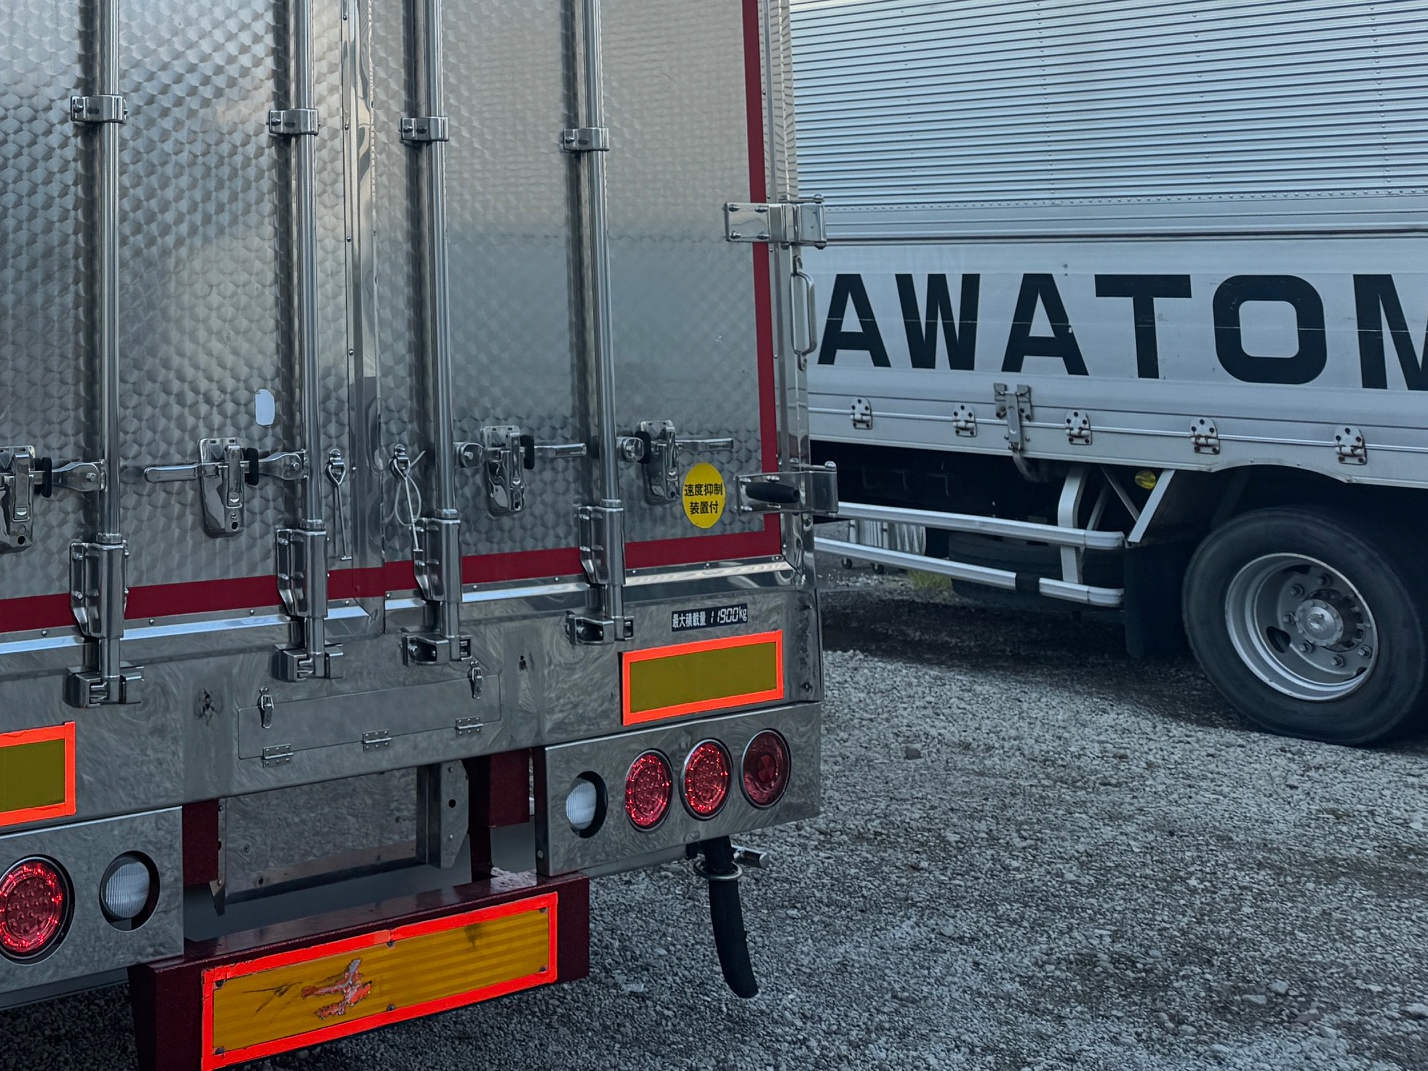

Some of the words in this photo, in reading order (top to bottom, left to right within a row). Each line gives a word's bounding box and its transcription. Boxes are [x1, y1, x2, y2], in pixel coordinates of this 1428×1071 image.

[684, 483, 723, 497] 速度抑制
[689, 500, 719, 515] 装置付
[672, 611, 706, 628] 最大積載量
